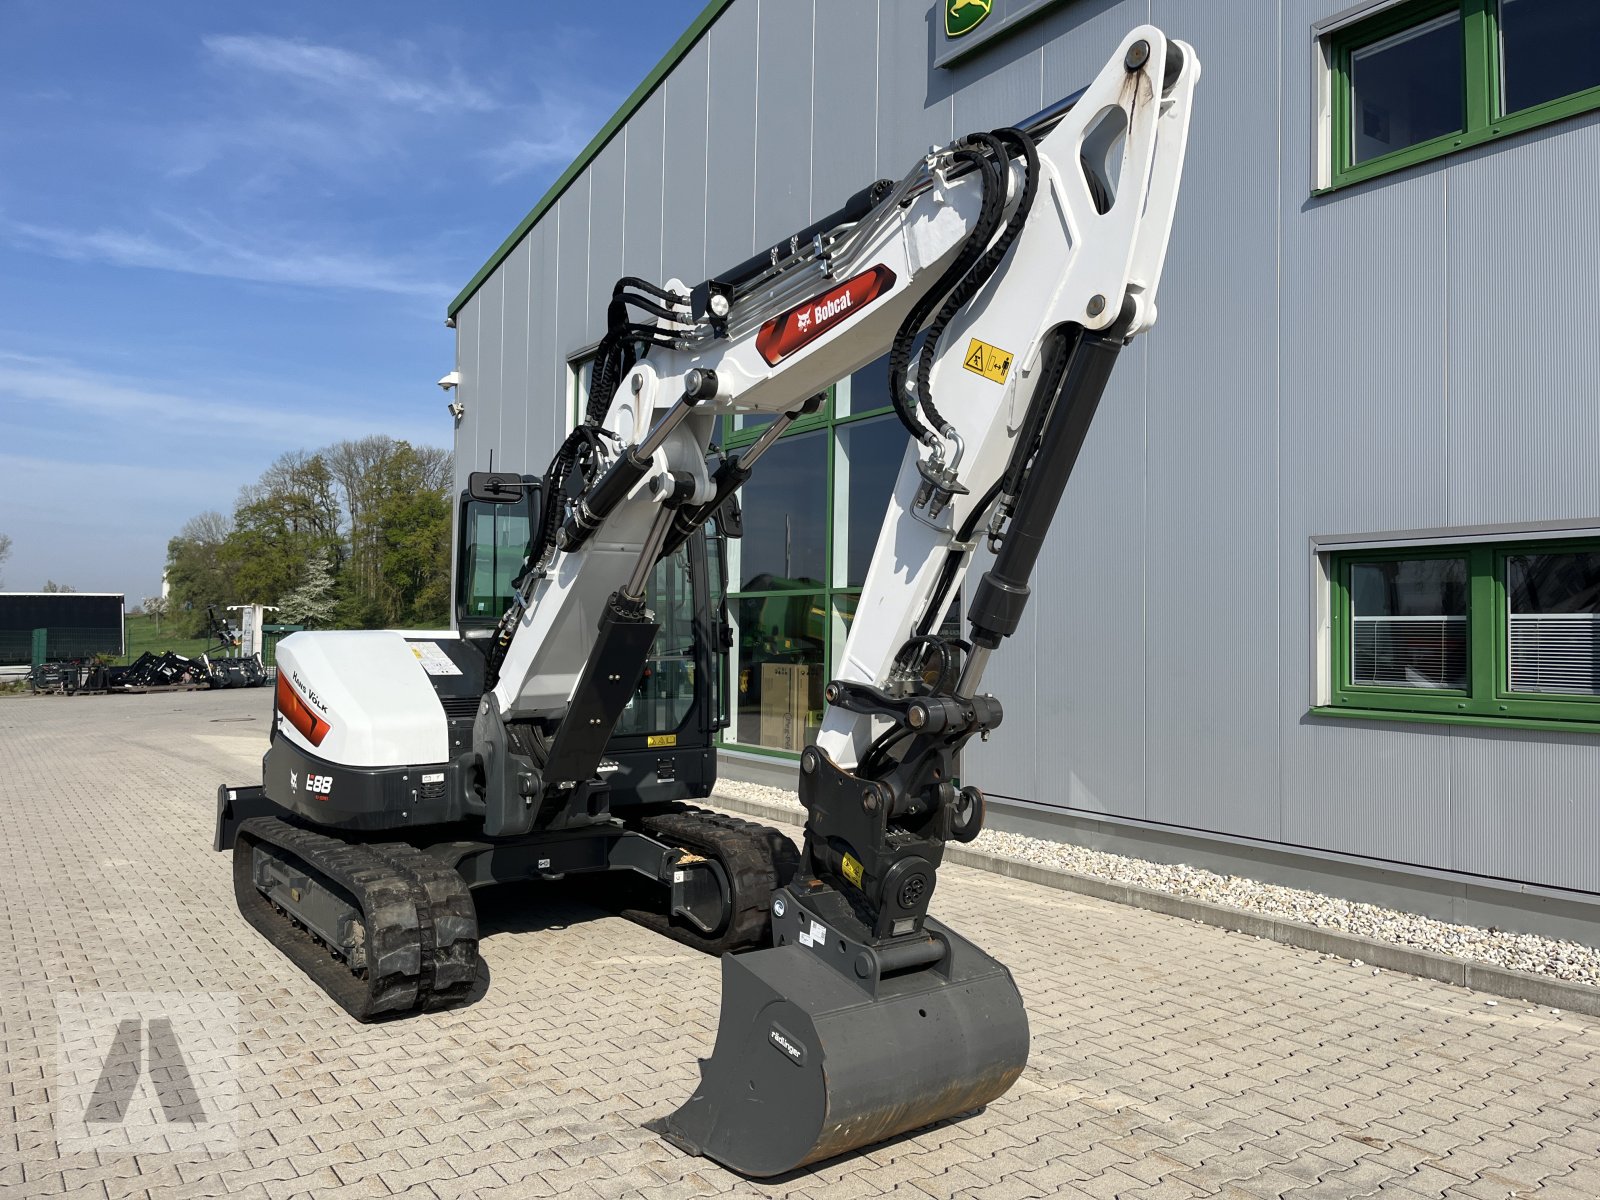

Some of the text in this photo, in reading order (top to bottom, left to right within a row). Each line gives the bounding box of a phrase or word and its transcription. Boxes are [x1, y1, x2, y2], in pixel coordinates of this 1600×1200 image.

[814, 290, 852, 325] Bobcat
[308, 688, 329, 714] VÖLK
[305, 773, 334, 794] E88
[771, 1031, 801, 1058] rädlinger
